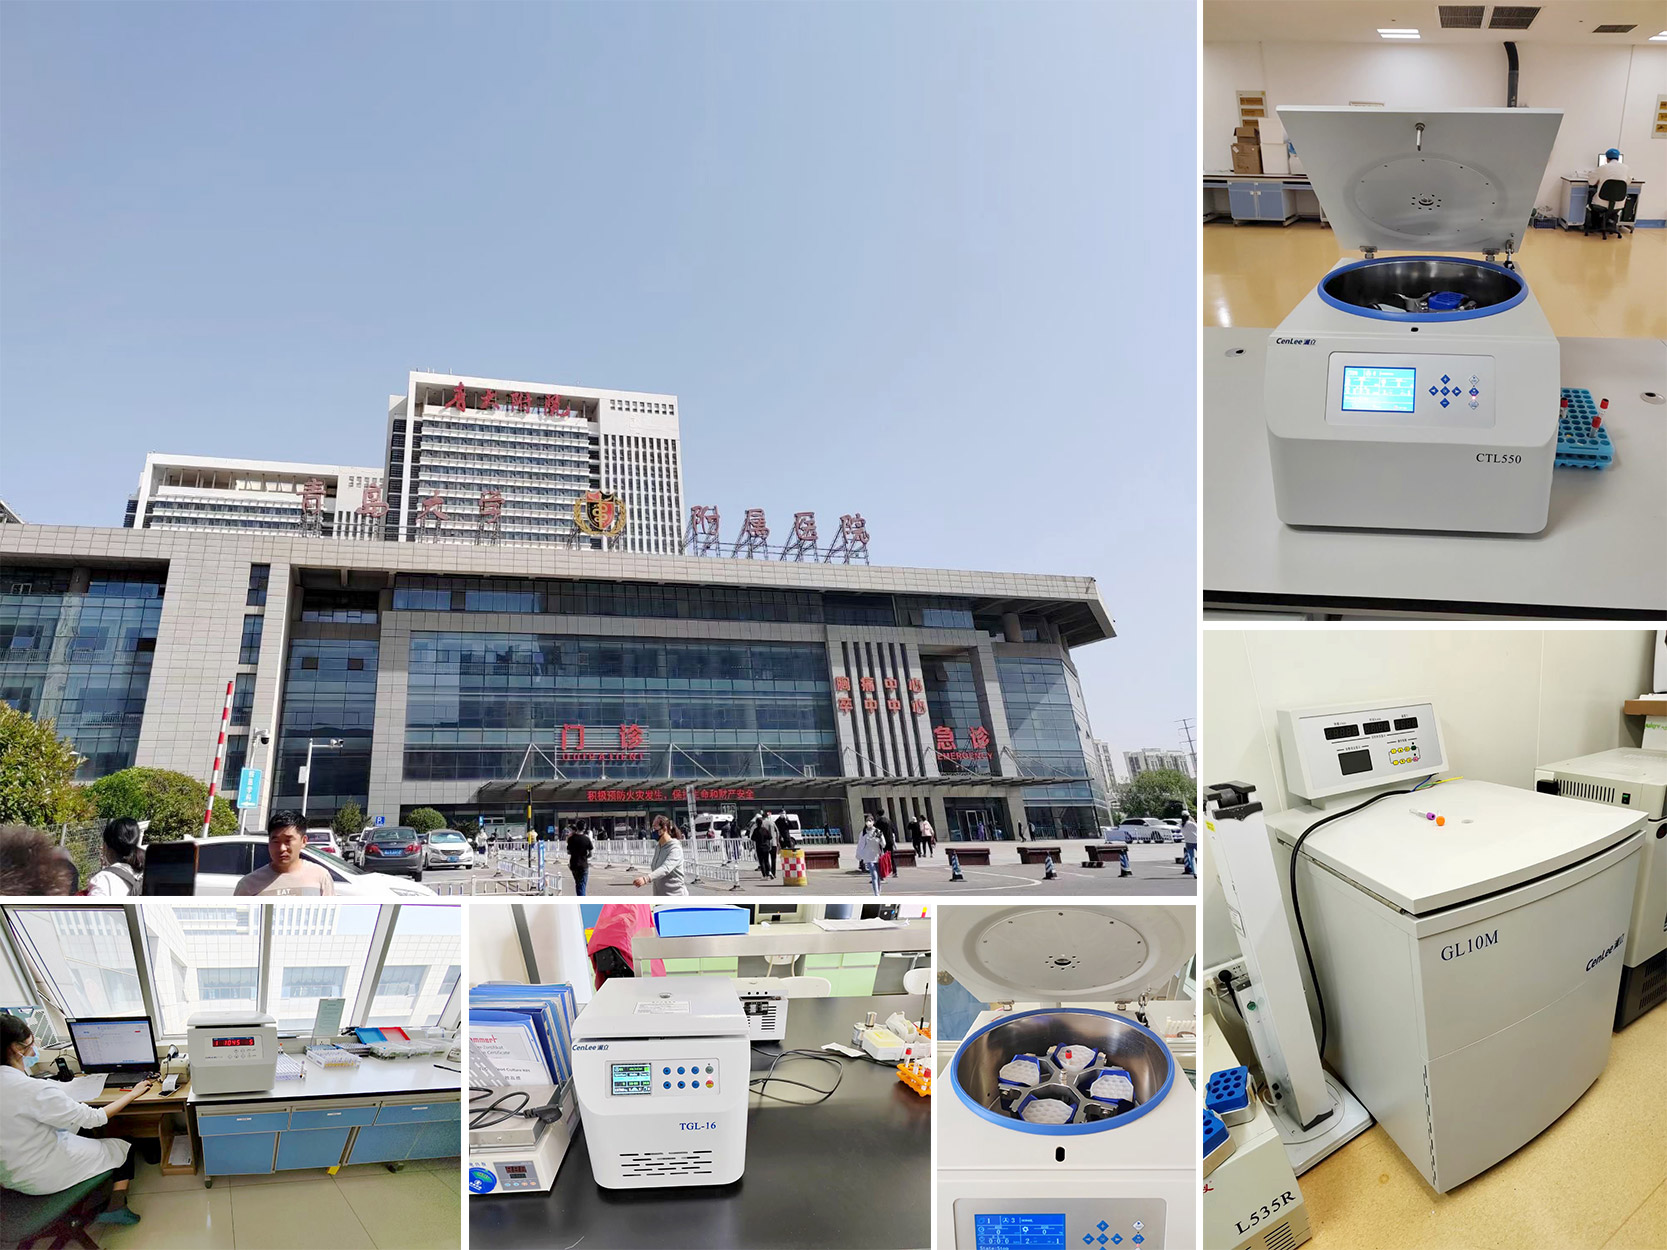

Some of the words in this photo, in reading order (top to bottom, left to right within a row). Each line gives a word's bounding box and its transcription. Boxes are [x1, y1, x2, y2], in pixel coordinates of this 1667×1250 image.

[1275, 337, 1303, 345] CenLee
[1476, 453, 1522, 464] CTL550
[296, 478, 505, 523] 青岛大学
[690, 504, 870, 544] 附属医院
[561, 723, 645, 750] 门诊
[934, 725, 990, 750] 急诊
[937, 752, 993, 760] EMERGENCY
[1441, 929, 1499, 961] GL10M
[1586, 945, 1614, 972] CenLee
[679, 1121, 717, 1131] TGL-16
[1234, 1190, 1297, 1236] L535R
